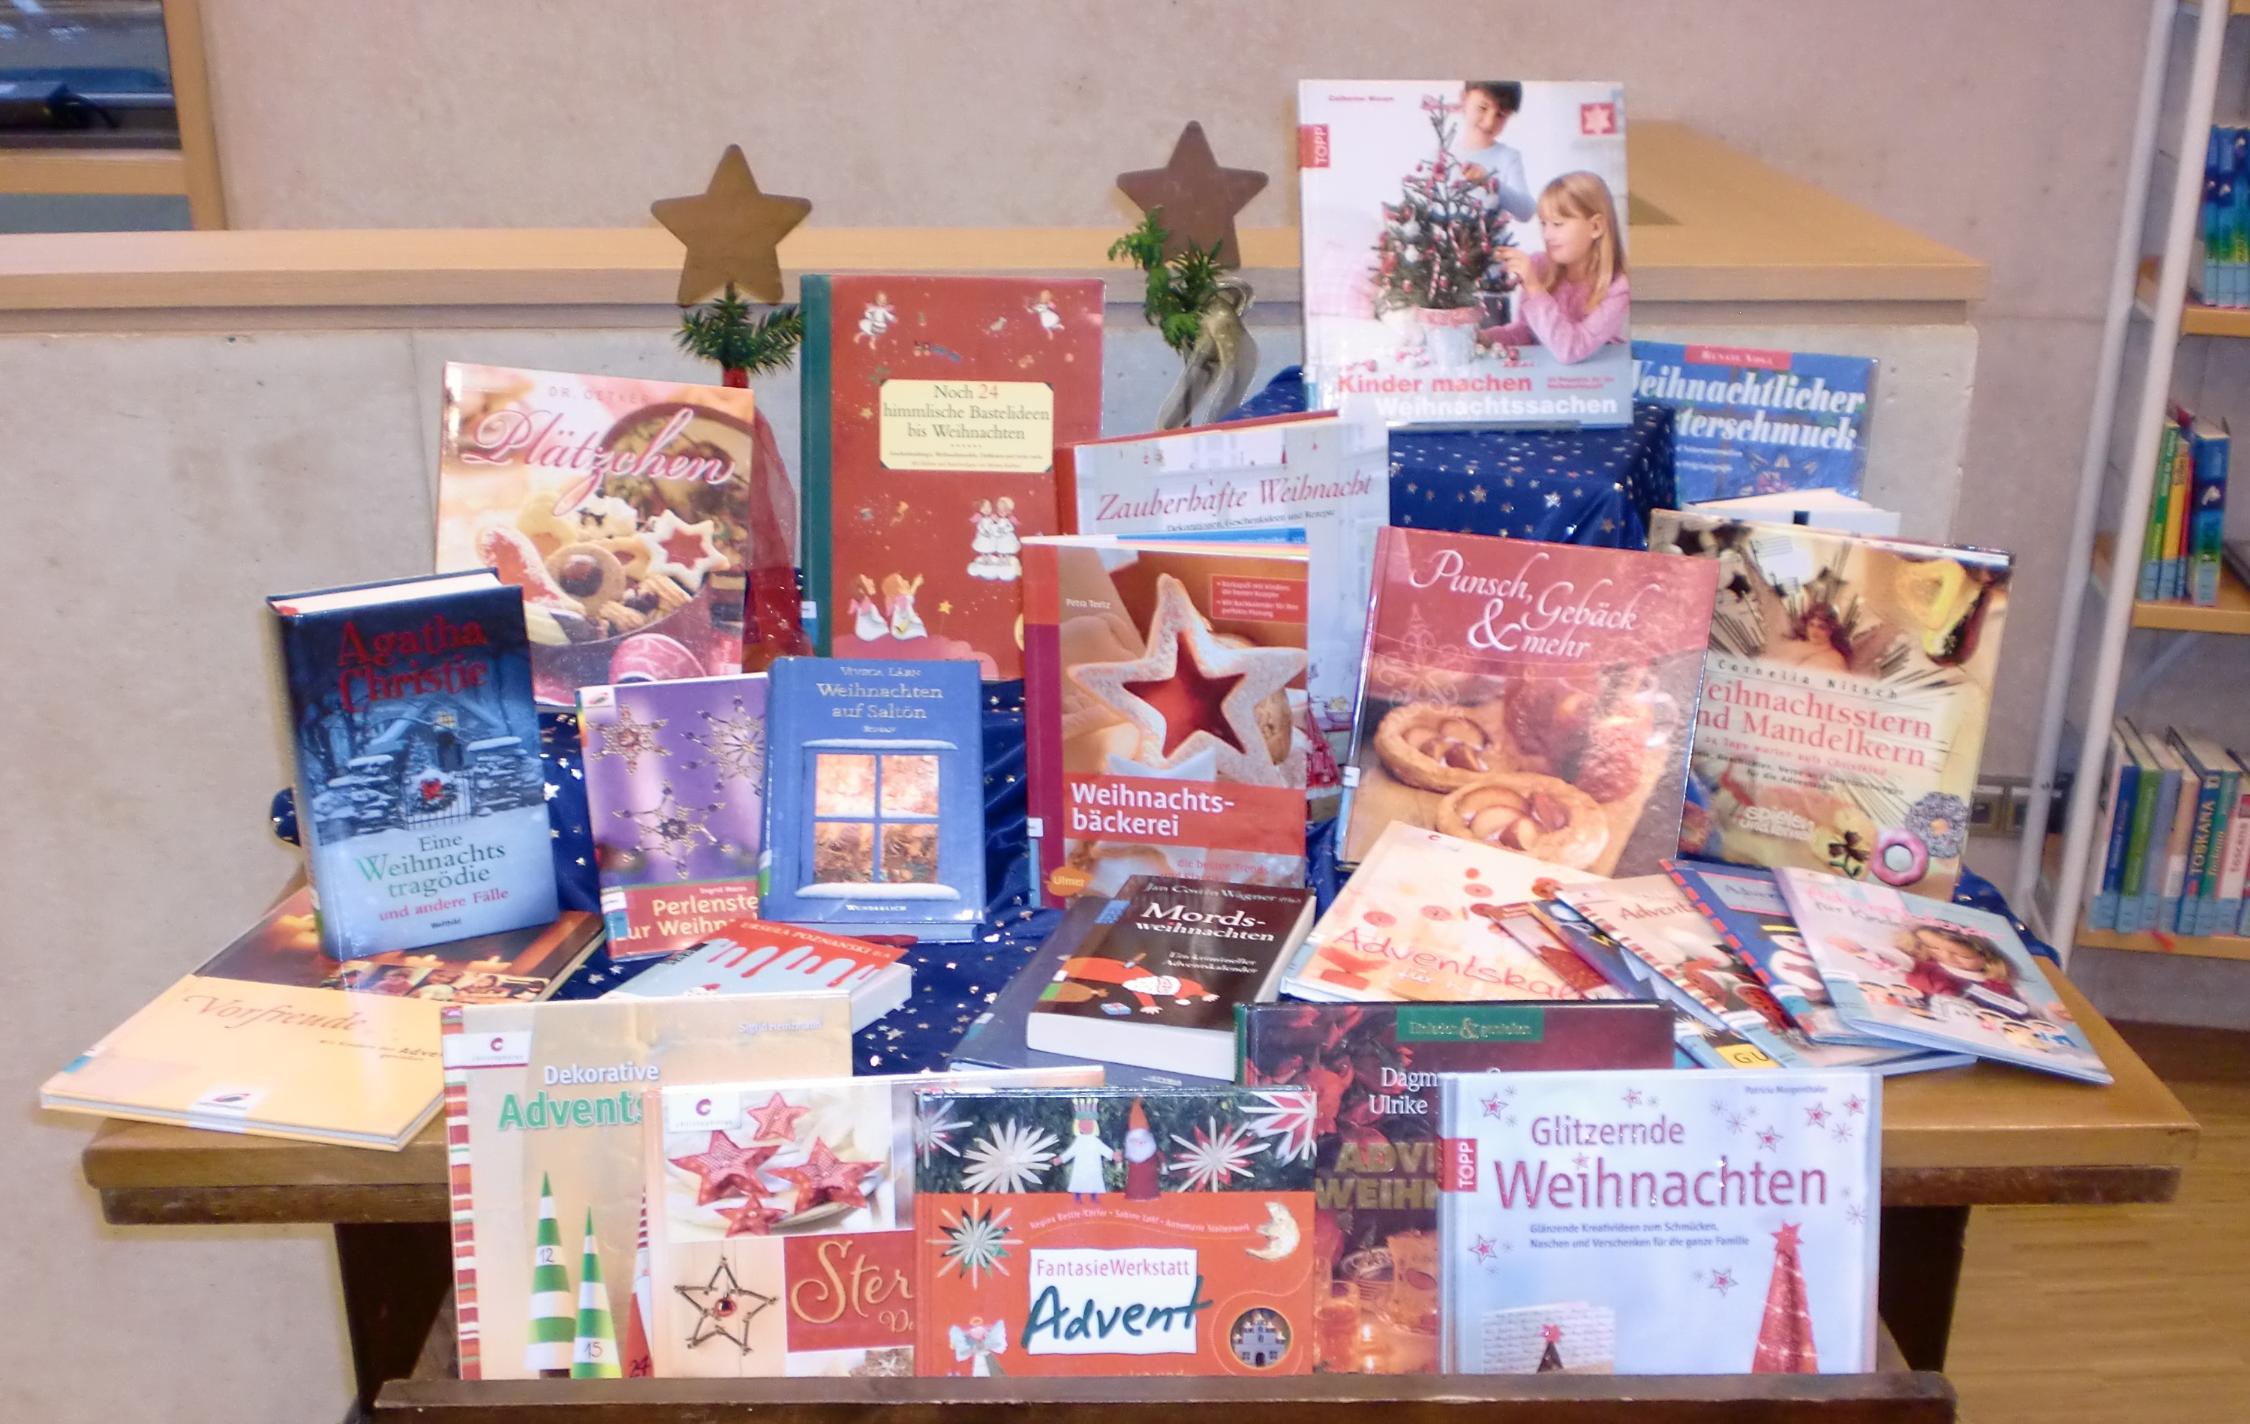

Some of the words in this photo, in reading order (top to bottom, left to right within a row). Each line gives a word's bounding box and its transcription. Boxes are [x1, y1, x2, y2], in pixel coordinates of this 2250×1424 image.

[1314, 126, 1330, 166] TOPP
[933, 385, 974, 400] Noch
[977, 384, 999, 400] 24
[1338, 374, 1421, 393] Kinder
[1432, 374, 1533, 393] machen
[883, 403, 965, 420] himmlische
[969, 405, 1050, 421] Bastelideen
[1376, 395, 1618, 417] Weihnachtssachen
[907, 422, 928, 438] bis
[932, 424, 1026, 441] Weihnachten
[461, 407, 735, 517] Plätzchen
[1096, 479, 1248, 522] Zauberhafte
[1259, 469, 1372, 506] Weihnacht
[1408, 550, 1550, 605] Punsch,
[1520, 578, 1662, 632] Gebäck
[337, 613, 488, 666] Agatha
[1467, 597, 1522, 652] &
[1520, 629, 1592, 659] mehr
[338, 652, 488, 714] Christie
[815, 682, 944, 699] Weihnachten
[1717, 658, 1811, 686] Cornelia
[1827, 677, 1900, 701] Nitsch
[831, 703, 864, 719] auf
[866, 702, 928, 719] Saltön
[1704, 677, 1934, 739] eihnachtsstern
[1695, 706, 1731, 731] nd
[1743, 713, 1926, 768] Mandelkern
[1071, 782, 1235, 813] Weihnachts-
[1072, 807, 1180, 837] bäckerei
[418, 833, 464, 851] Eine
[356, 843, 507, 883] Weihnachts
[387, 865, 491, 898] tragödie
[1053, 875, 1086, 889] Ulmer
[1144, 882, 1169, 893] Jan
[1214, 887, 1279, 904] Wagner
[379, 905, 410, 922] und
[415, 897, 467, 916] andere
[473, 888, 509, 904] Fälle
[1141, 901, 1267, 928] Mords-
[1134, 921, 1275, 943] weihnachten
[184, 994, 368, 1031] Vorfreude
[1460, 1017, 1480, 1040] &
[1733, 1049, 1770, 1065] GU
[543, 1062, 660, 1087] Dekorative
[1381, 1067, 1442, 1092] Dagm
[1369, 1095, 1429, 1116] Ulrike
[1531, 1114, 1686, 1148] Glitzernde
[1457, 1140, 1475, 1189] TOPP
[1493, 1154, 1828, 1210] Weihnachten
[1529, 1223, 1580, 1234] Glänzende
[1642, 1223, 1663, 1233] zum
[537, 1247, 555, 1265] 12
[1572, 1238, 1591, 1248] und
[1592, 1238, 1651, 1249] Verschenken
[1653, 1237, 1667, 1248] für
[1669, 1237, 1683, 1247] die
[1686, 1238, 1714, 1250] ganze
[1036, 1258, 1191, 1278] FantasieWerkstatt
[1020, 1274, 1214, 1349] Advent
